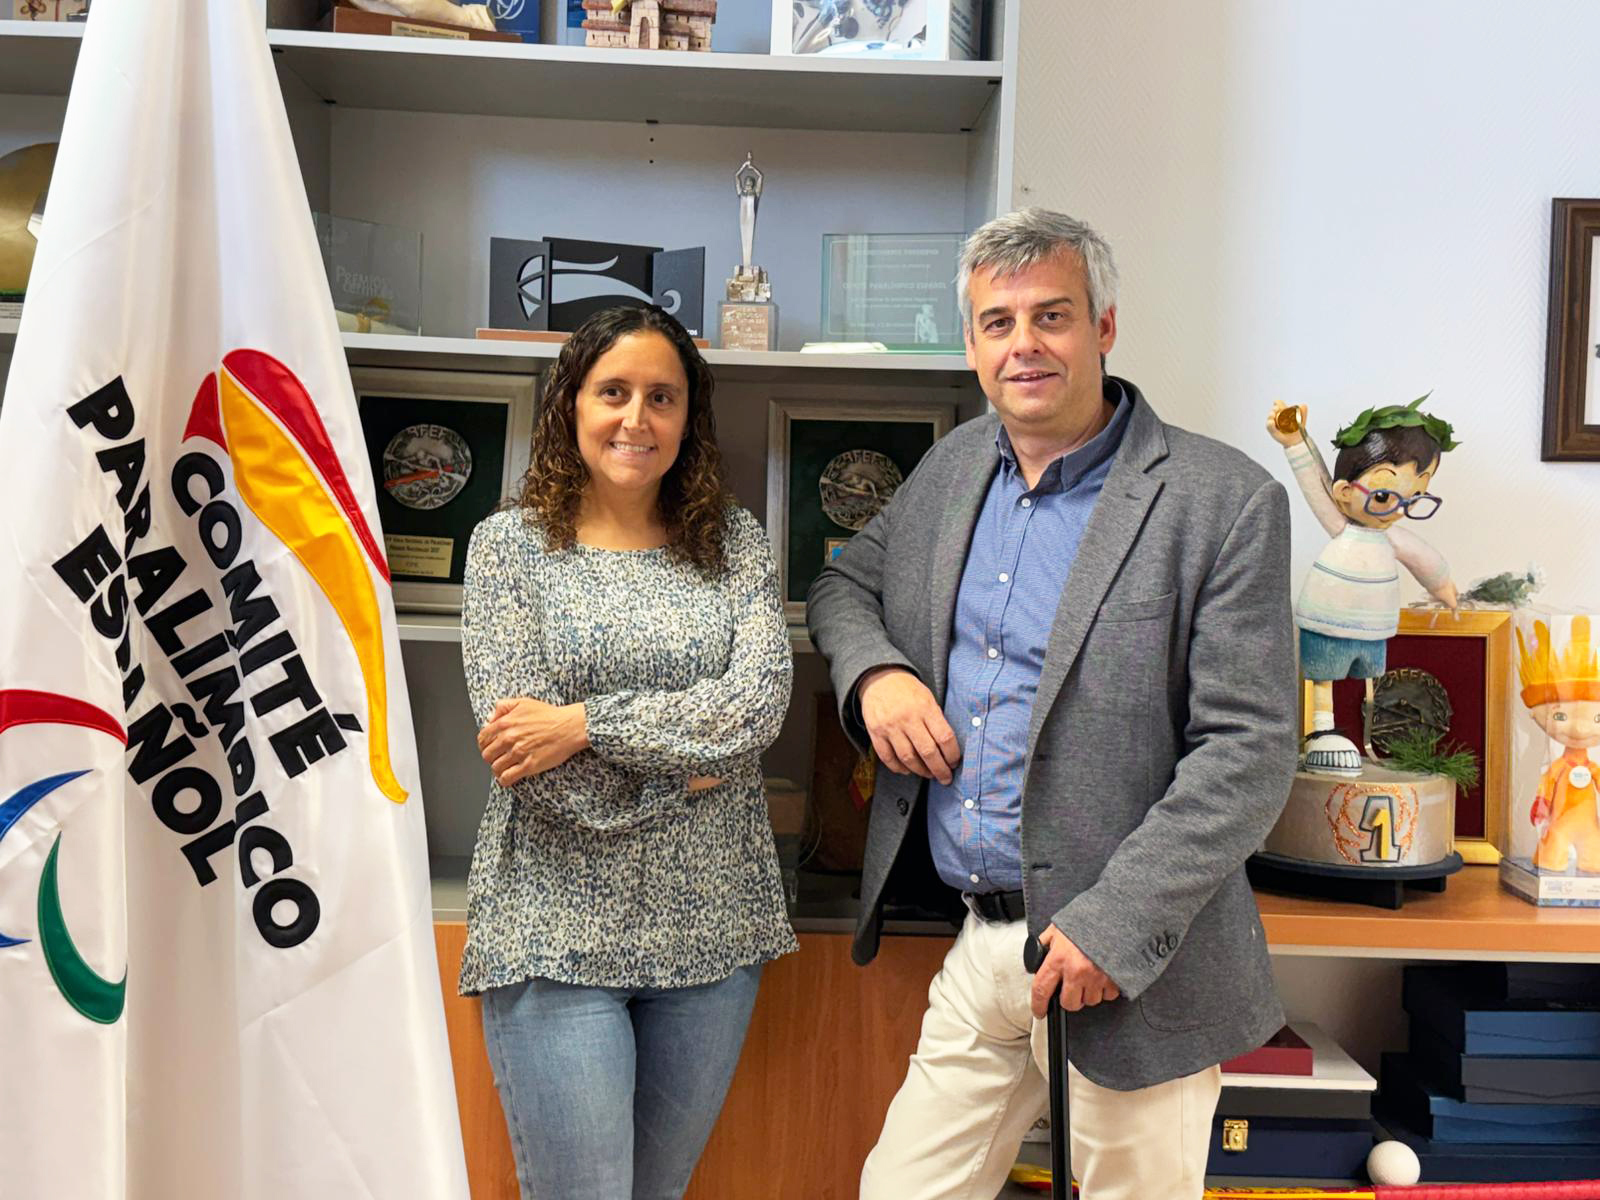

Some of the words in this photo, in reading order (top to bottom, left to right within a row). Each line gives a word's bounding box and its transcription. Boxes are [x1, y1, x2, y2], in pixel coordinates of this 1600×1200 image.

[52, 524, 235, 887] ESAÑOL
[67, 376, 321, 948] PARALÍMPICO
[171, 452, 363, 778] COMITÉ
[1359, 795, 1401, 863] 1
